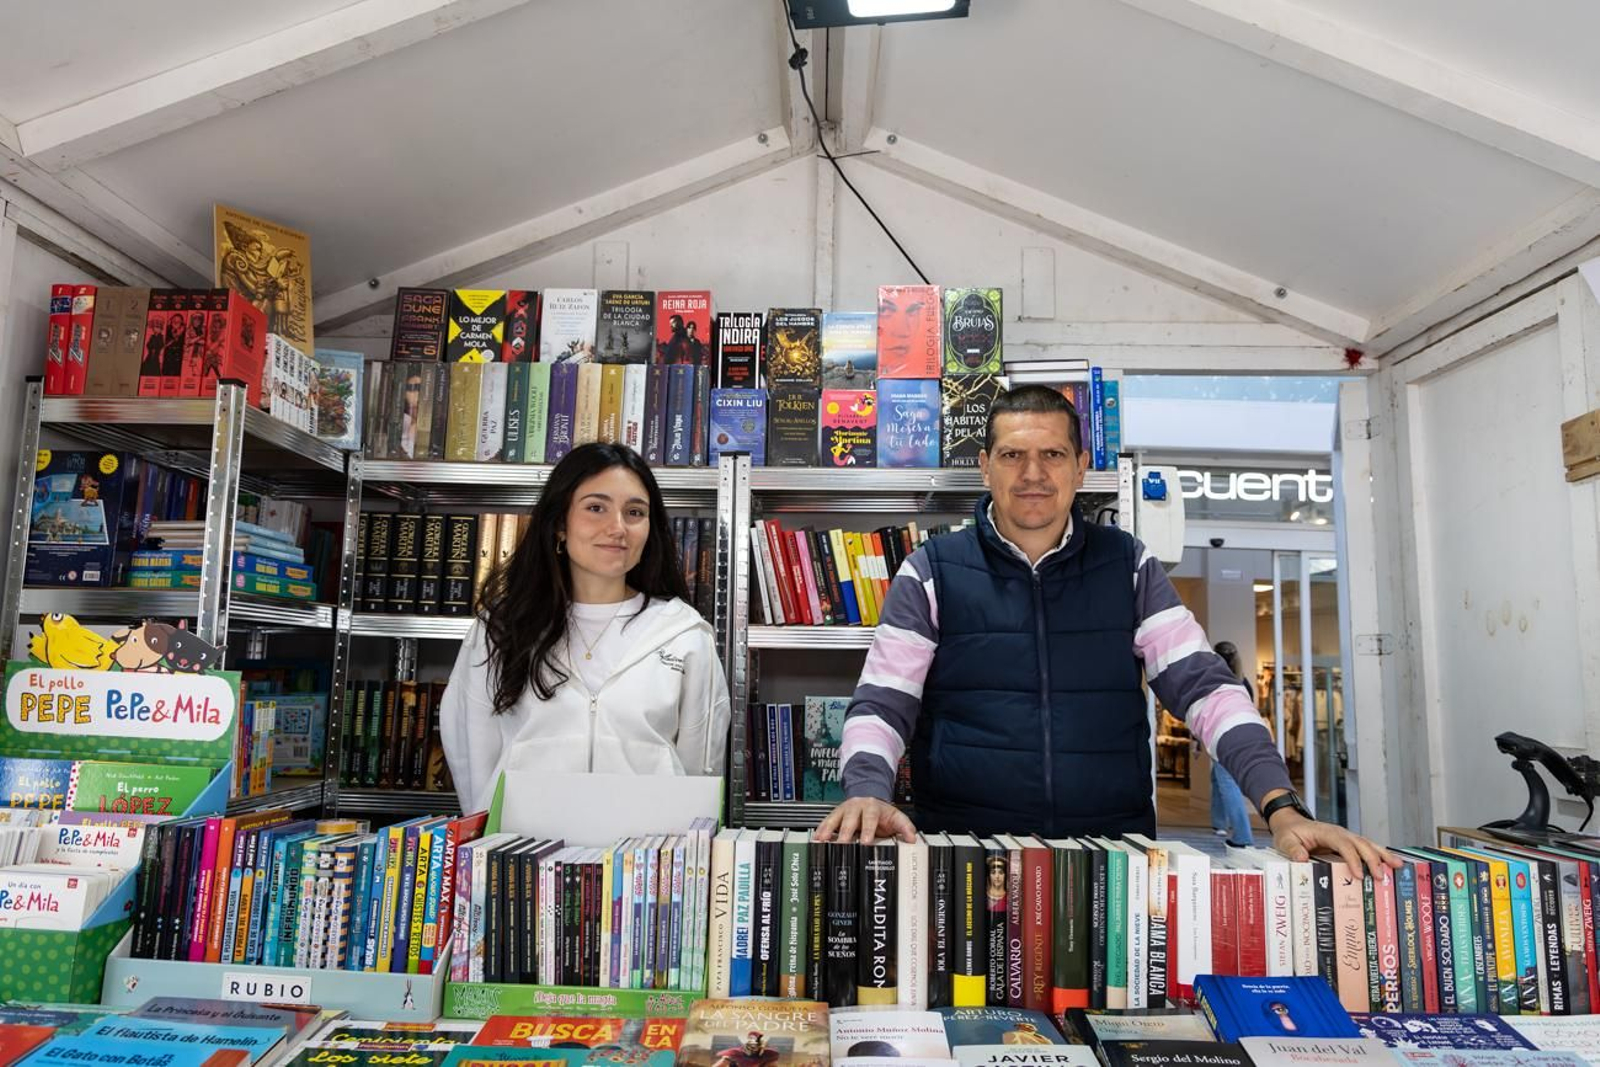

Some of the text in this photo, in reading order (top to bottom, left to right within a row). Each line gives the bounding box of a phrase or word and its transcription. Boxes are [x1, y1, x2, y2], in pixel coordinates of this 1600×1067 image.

[402, 303, 440, 314] DUNE
[662, 299, 708, 310] REINA ROJA
[458, 316, 497, 324] LO MEJOR
[775, 316, 815, 324] LOS JUEGOS
[460, 333, 492, 341] CARMEN
[711, 399, 763, 408] CIXIN LIU
[775, 400, 816, 412] TOLKIEN
[966, 403, 986, 413] LOS
[894, 404, 923, 423] Saga
[507, 409, 520, 442] ULISES
[954, 427, 976, 439] DEL
[951, 460, 976, 468] HOLLY
[452, 522, 461, 559] MARTIN
[30, 673, 85, 692] El pollo
[20, 692, 92, 725] PEPE
[117, 781, 159, 796] El perro
[99, 793, 173, 816] LÓPEZ
[430, 836, 444, 871] ARTA
[441, 838, 456, 903] ARTA MAX
[564, 866, 571, 874] 5
[790, 872, 800, 886] Soto
[8, 880, 18, 888] Un
[30, 883, 42, 891] con
[270, 862, 281, 903] ALDEANO
[410, 847, 428, 957] ARTA CHISTES RETOS
[713, 871, 730, 919] VIDA
[736, 862, 750, 923] PAZ PADILLA
[790, 887, 800, 903] José
[283, 867, 300, 943] INFRAMUNDO
[1582, 898, 1594, 929] ZWEIG
[759, 890, 771, 960] OFENSA AL FRÍO
[1133, 911, 1141, 934] NIEVE
[1274, 894, 1287, 966] STEFAN ZWEIG
[1316, 905, 1335, 952] FANTASMAS
[1420, 892, 1433, 961] VIRGINIA WOOLF
[715, 922, 725, 963] FRANCISCO
[872, 878, 887, 989] MALDITA ROM
[1133, 935, 1140, 945] LA
[1403, 899, 1417, 969] SHERLOCK HOLMES
[827, 949, 856, 957] SUEÑOS
[989, 929, 999, 991] ROBERTO CORRAL
[996, 921, 1006, 1000] GALA DE HISPANIA
[1133, 946, 1140, 956] DE
[1149, 915, 1167, 996] DAMA BLANCA
[1438, 914, 1455, 1004] EL BUEN SOLDADO
[1473, 934, 1485, 975] CASCANUECES
[788, 954, 798, 972] reina
[1008, 937, 1022, 999] CALVARIO
[1367, 930, 1380, 1002] OTRA VUELTA TUERCA
[1546, 922, 1564, 1010] RIMAS LEYENDAS
[1033, 971, 1044, 994] REY
[1381, 943, 1400, 1014] PERROS
[1487, 982, 1498, 992] EL
[1500, 971, 1516, 1005] ANA
[230, 981, 304, 998] RUBIO
[1457, 973, 1475, 1006] ANA
[1521, 973, 1537, 1007] ANA
[1132, 996, 1140, 1006] LA
[149, 1004, 283, 1025] La Princesa y el Guisante
[699, 1011, 819, 1022] LA SANGRE
[953, 1009, 1023, 1017] ARTURO
[97, 1025, 112, 1037] El
[116, 1026, 178, 1043] flautista
[179, 1031, 198, 1044] de
[509, 1022, 614, 1042] BUSCA
[646, 1025, 678, 1037] EN
[704, 1020, 809, 1031] DEL PADRE
[836, 1026, 874, 1034] Antonio
[911, 1026, 945, 1034] Molina
[642, 1036, 674, 1048] LA
[1268, 1043, 1368, 1056] Juan del Val
[45, 1047, 60, 1060] El
[61, 1049, 100, 1063] Gato
[102, 1054, 128, 1065] con
[308, 1051, 435, 1065] Los siete
[987, 1055, 1070, 1064] JAVIER
[1130, 1053, 1242, 1066] Sergio del Molino
